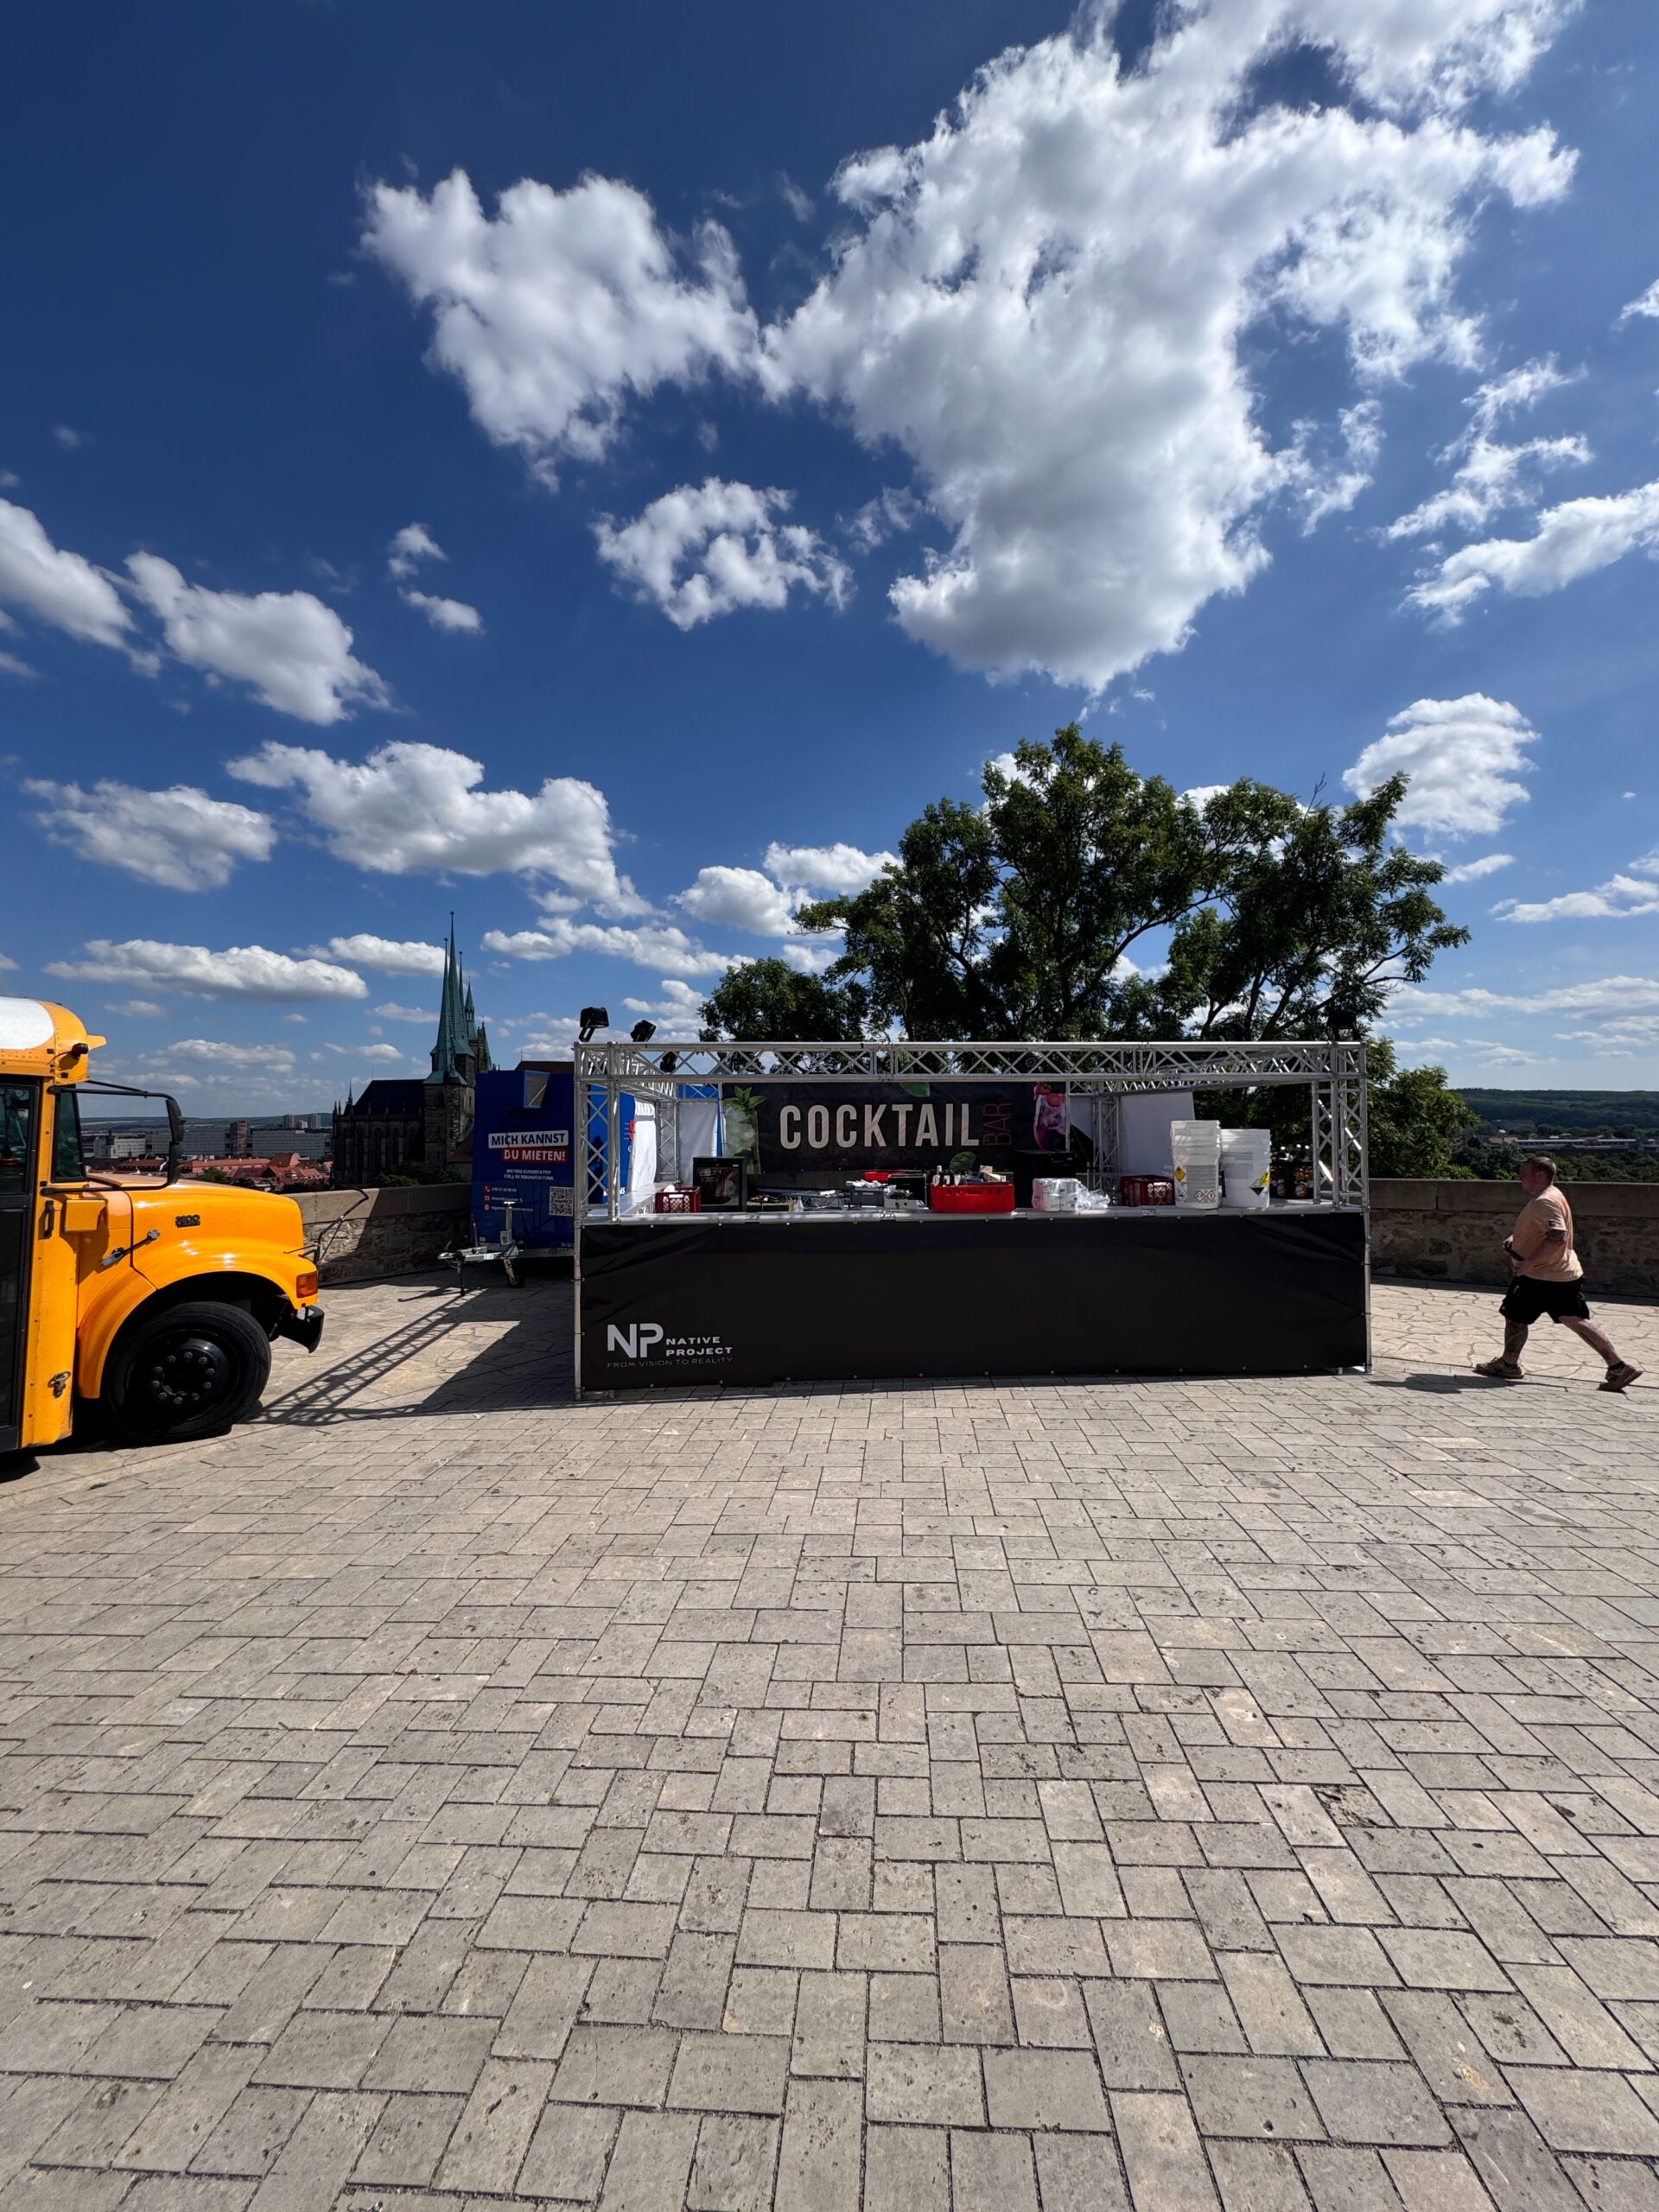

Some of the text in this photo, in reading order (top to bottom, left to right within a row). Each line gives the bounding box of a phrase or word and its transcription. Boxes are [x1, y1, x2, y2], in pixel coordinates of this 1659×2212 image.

[780, 1103, 980, 1150] COCKTAIL
[982, 1103, 1012, 1146] BAR
[492, 1133, 565, 1146] MICH KANNST
[504, 1149, 566, 1161] DU MIETEN!
[607, 1323, 664, 1358] NP
[665, 1337, 721, 1345] NATIVE
[665, 1347, 733, 1357] PROJECT
